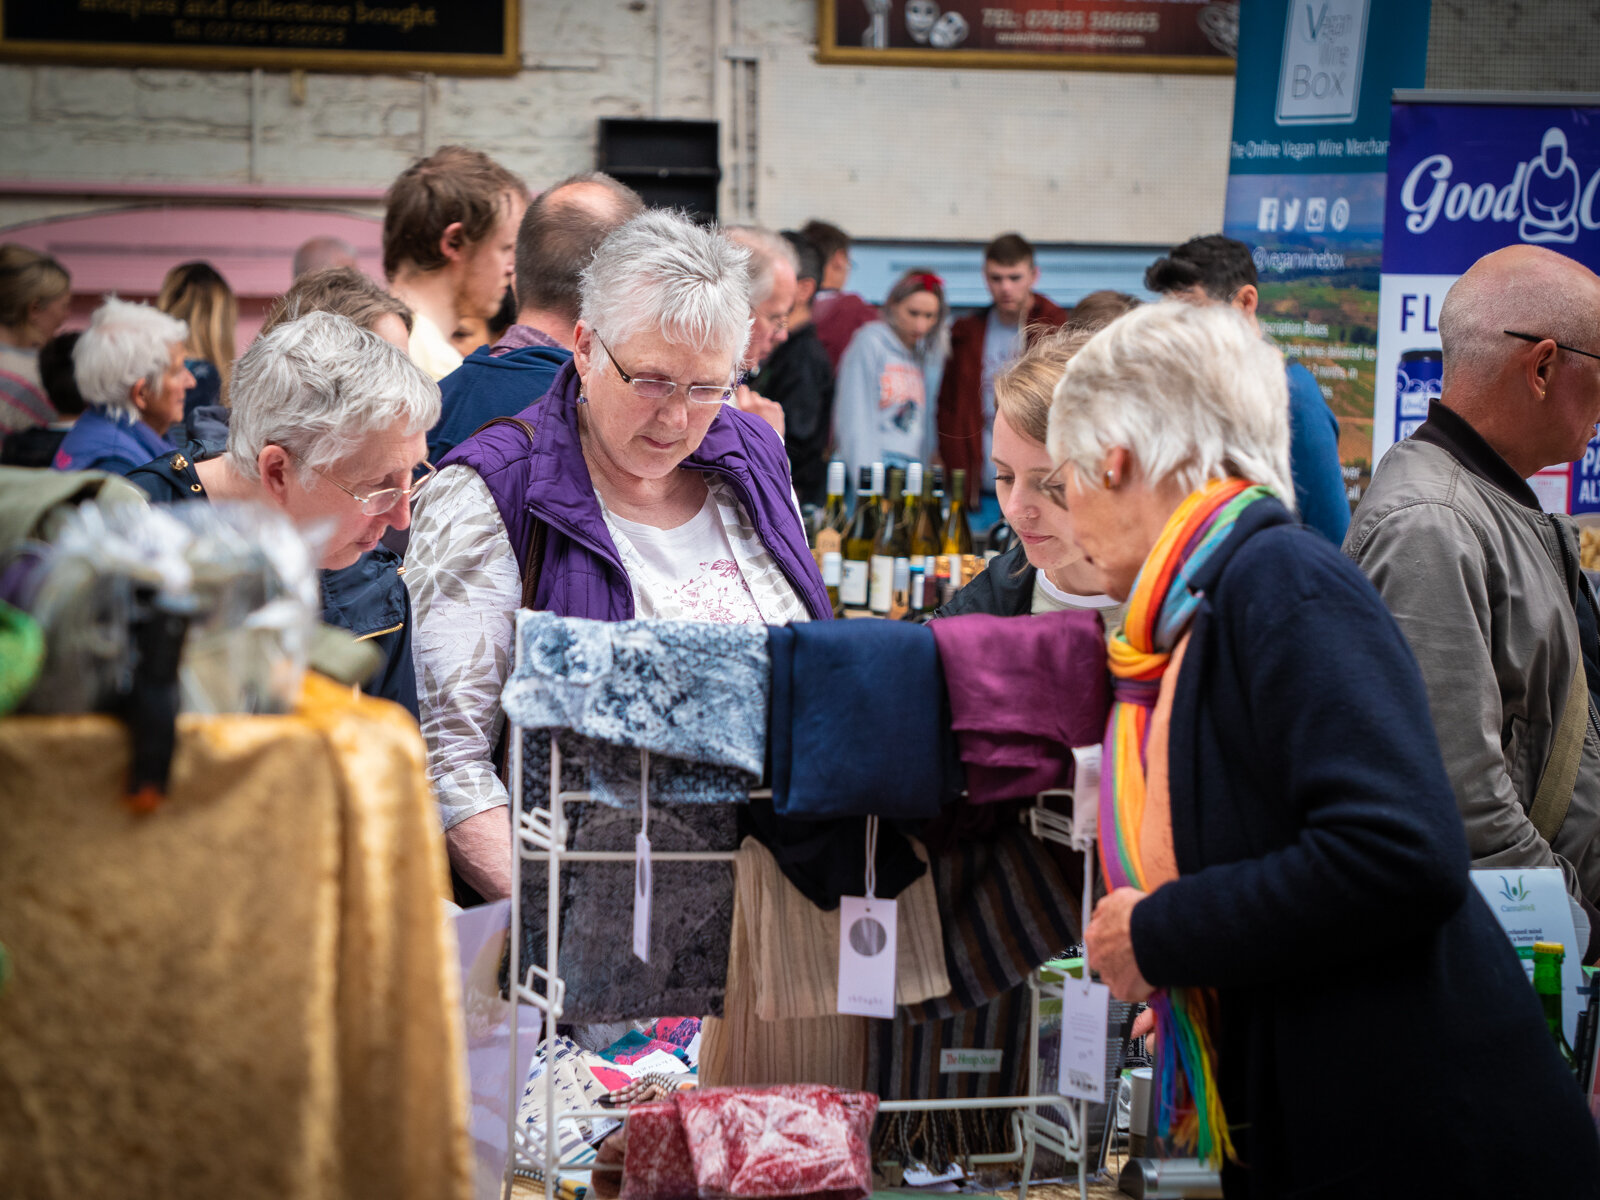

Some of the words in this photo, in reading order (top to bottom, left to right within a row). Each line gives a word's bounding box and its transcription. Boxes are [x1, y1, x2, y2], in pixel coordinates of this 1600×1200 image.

[183, 0, 226, 18] and
[230, 0, 349, 23] collections
[354, 1, 436, 33] bought
[1292, 63, 1347, 100] Box
[1245, 140, 1281, 159] Online
[1282, 139, 1316, 161] Vegan
[1316, 137, 1344, 157] Wine
[1400, 154, 1528, 234] Good
[1401, 293, 1439, 333] FL
[1578, 479, 1600, 504] AL
[945, 1053, 958, 1066] The
